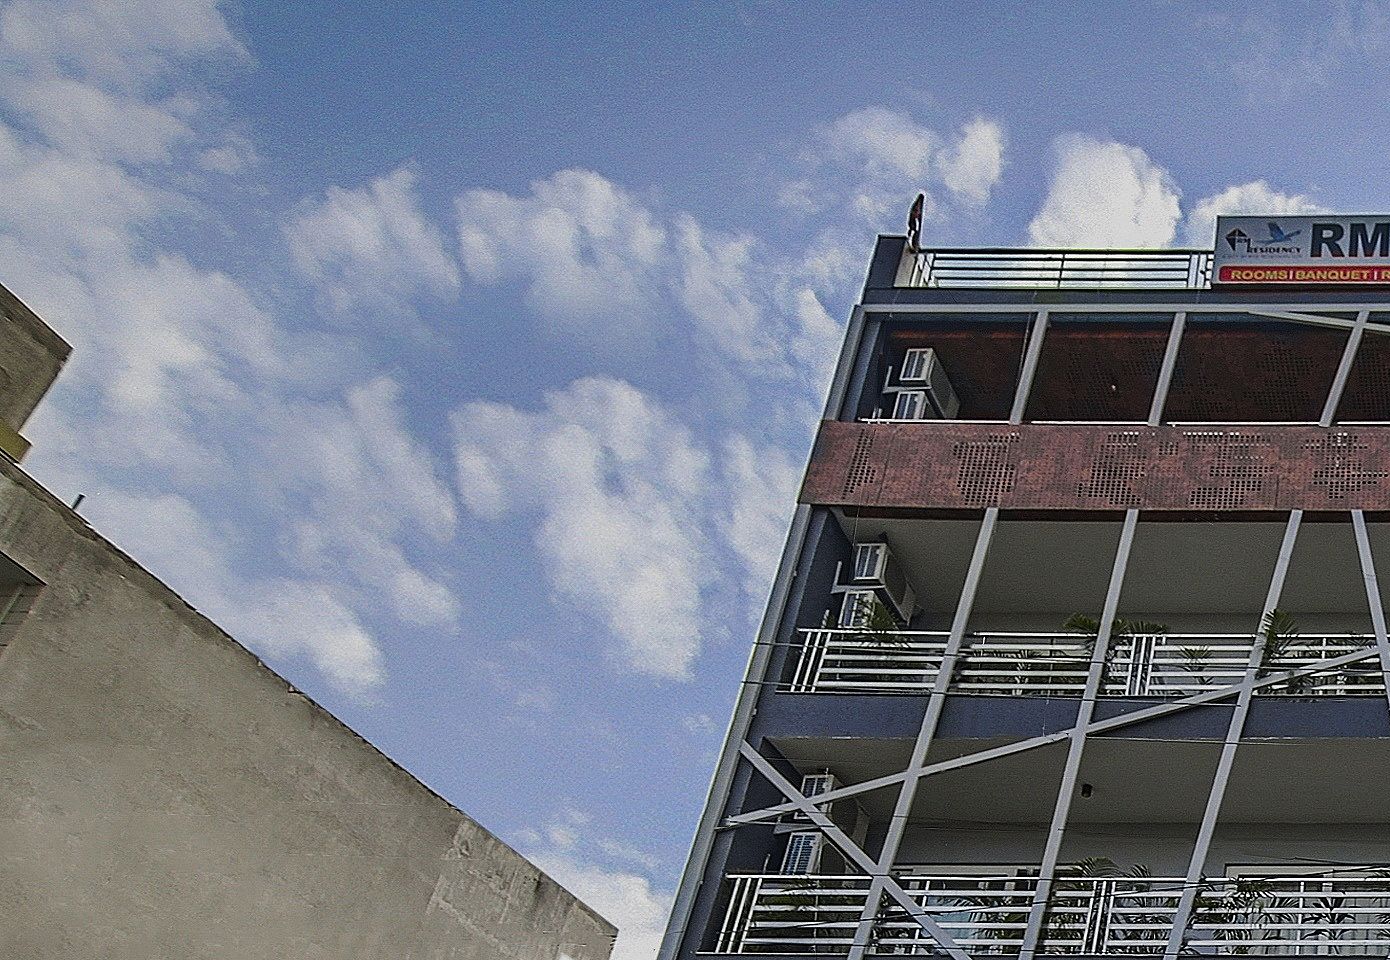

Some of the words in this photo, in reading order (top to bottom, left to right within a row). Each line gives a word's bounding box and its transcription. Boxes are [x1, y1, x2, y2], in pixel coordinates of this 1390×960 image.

[1310, 222, 1390, 258] RM
[1231, 269, 1289, 280] ROOMS
[1296, 269, 1370, 280] BANQUET
